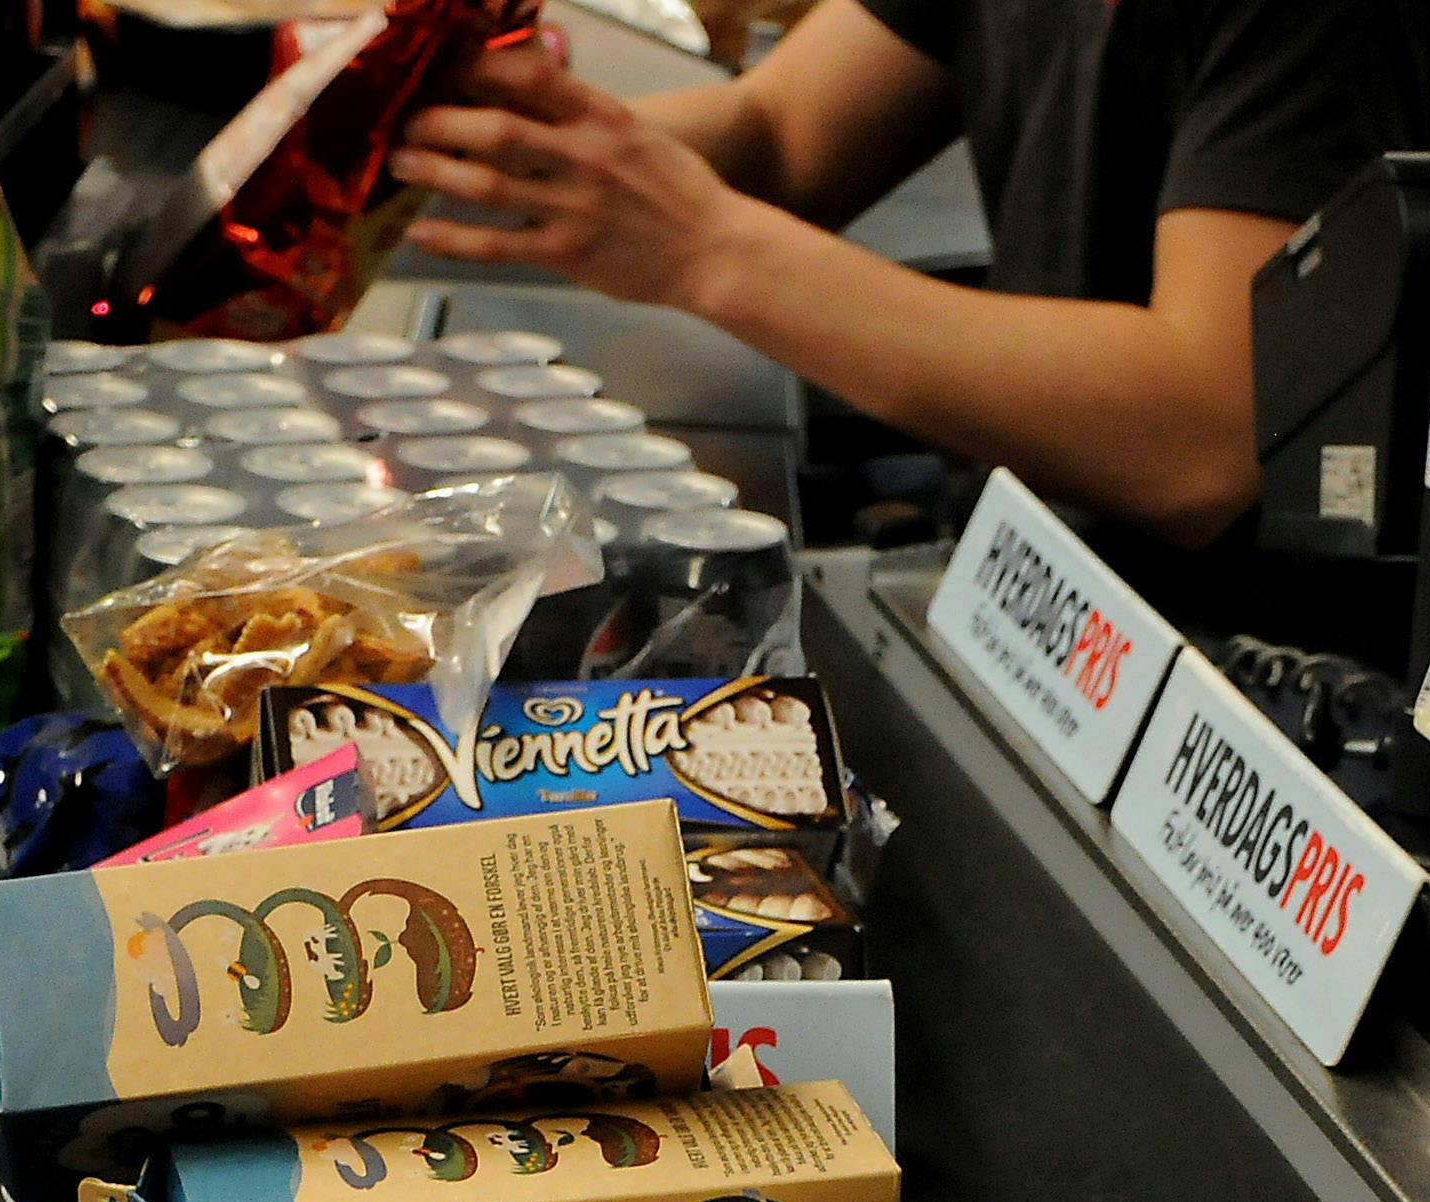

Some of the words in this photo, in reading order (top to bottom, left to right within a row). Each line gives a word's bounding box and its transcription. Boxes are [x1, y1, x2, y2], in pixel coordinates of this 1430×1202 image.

[973, 521, 1134, 711] HVERDAGSPRIS
[409, 688, 690, 811] Viennetta
[1165, 713, 1365, 956] HVERDAGSPRIS
[480, 853, 504, 901] FORSKEL
[488, 904, 506, 918] EN
[490, 921, 510, 944] GØR
[494, 946, 515, 976] VALG
[499, 978, 521, 1015] HVERT
